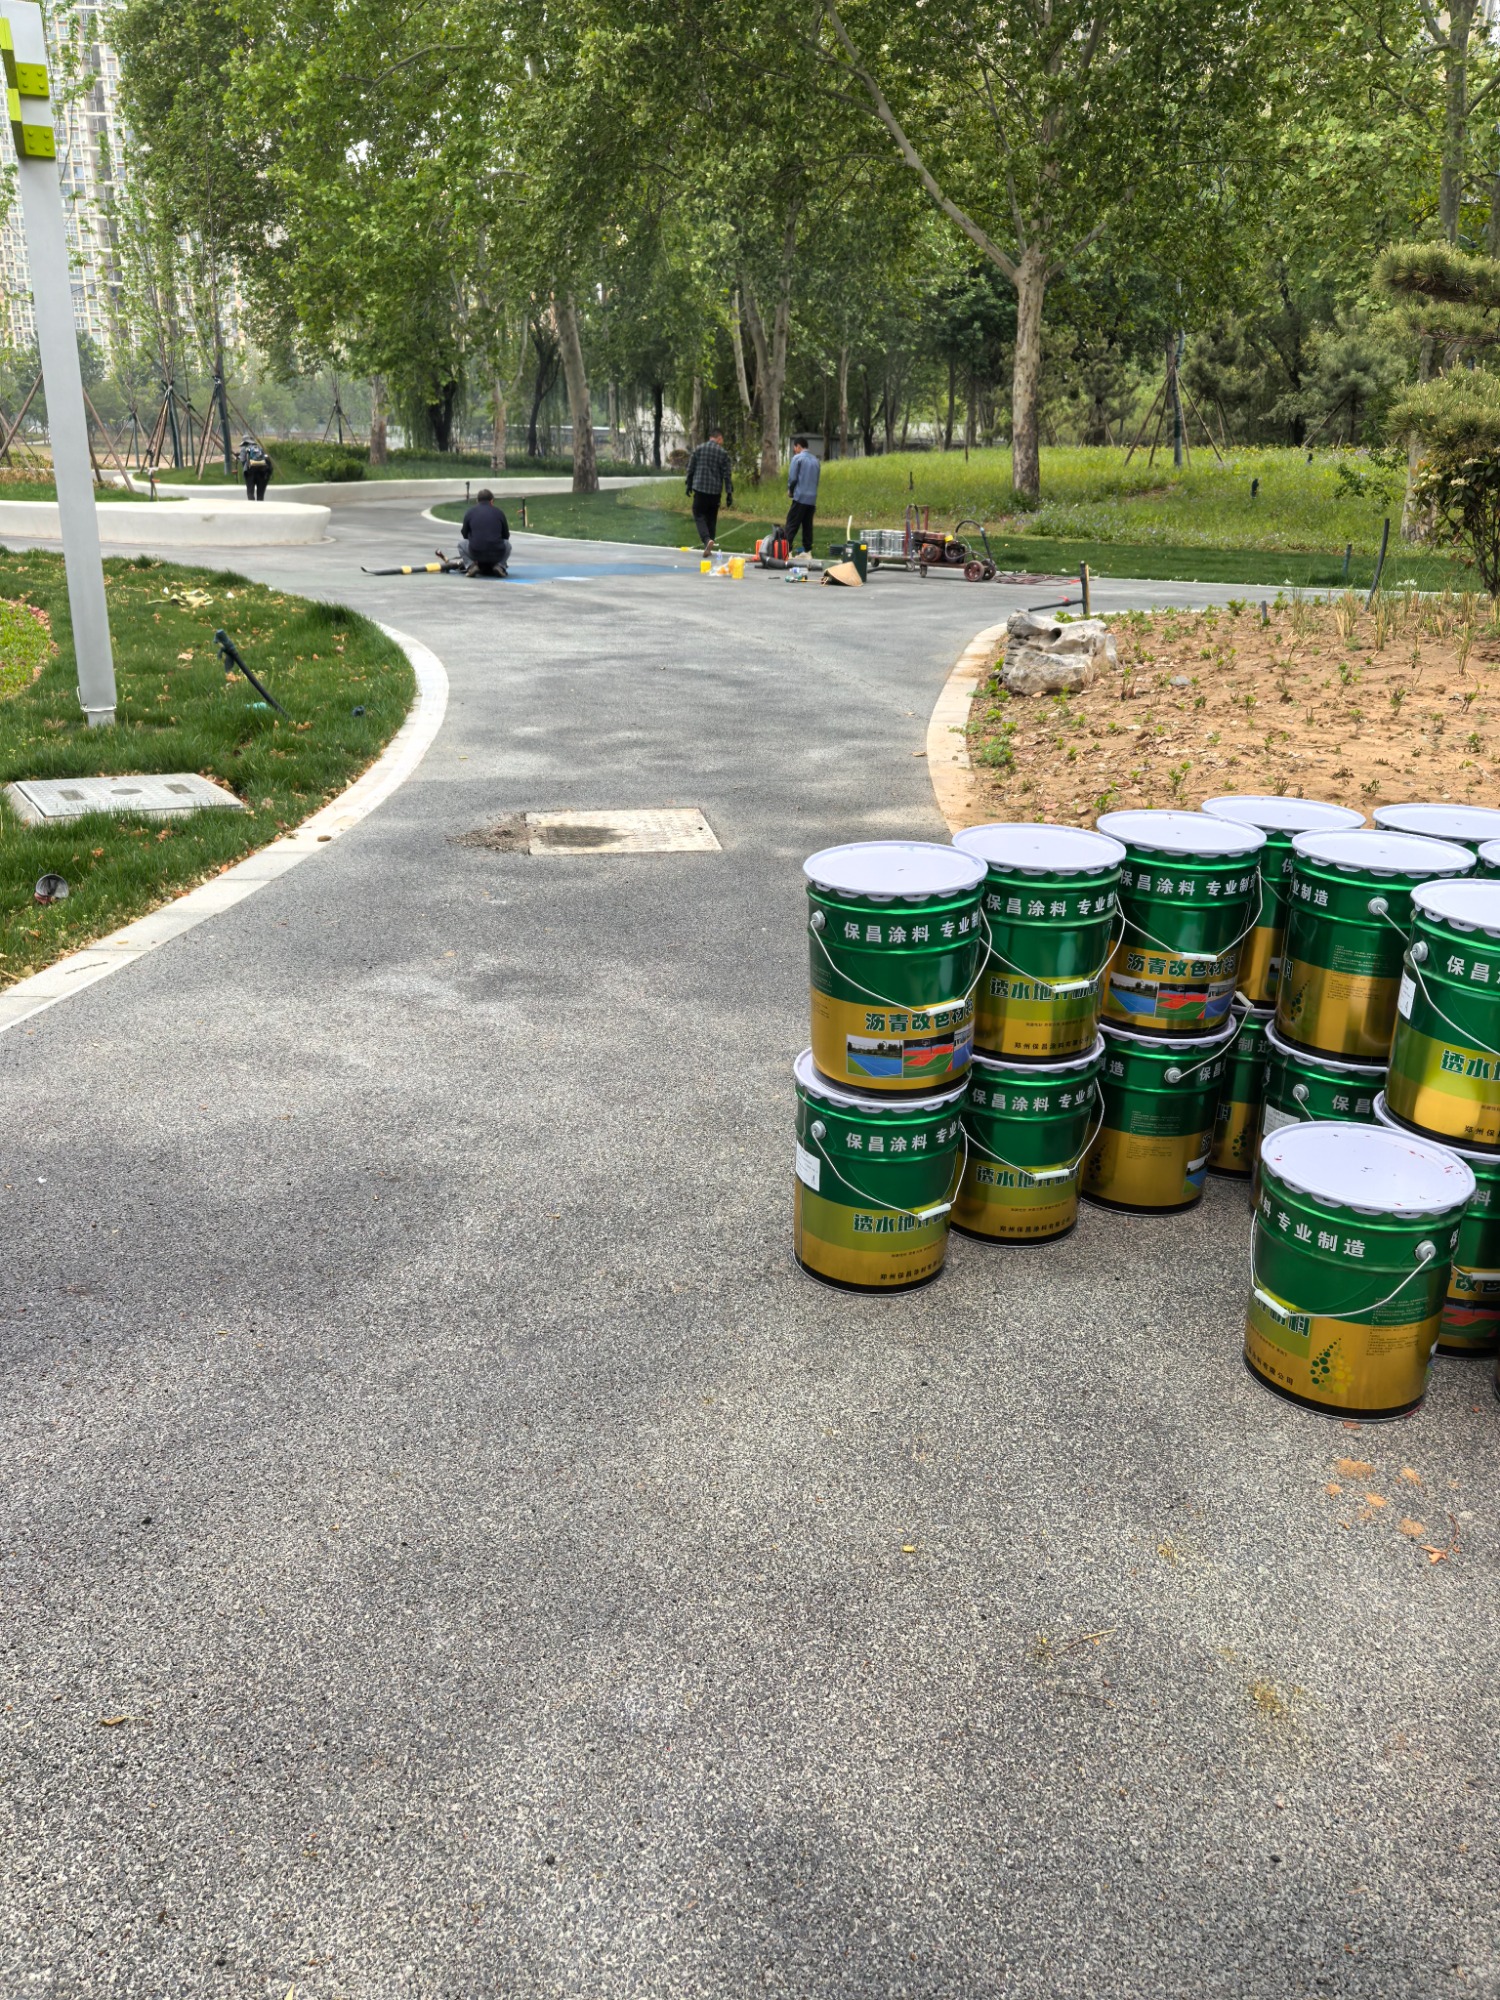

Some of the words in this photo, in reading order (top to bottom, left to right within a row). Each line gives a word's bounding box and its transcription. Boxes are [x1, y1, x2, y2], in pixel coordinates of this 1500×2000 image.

[1120, 868, 1196, 896] 保昌涂料
[986, 892, 1067, 917] 保昌涂料
[844, 920, 931, 944] 保昌涂料
[1447, 954, 1500, 985] 保昌
[1440, 1049, 1500, 1081] 透水
[972, 1087, 1050, 1112] 保昌涂料
[1332, 1094, 1371, 1114] 保昌
[846, 1132, 928, 1153] 保昌涂料
[1464, 1125, 1500, 1139] 郑州保
[1277, 1211, 1367, 1258] 专业制造
